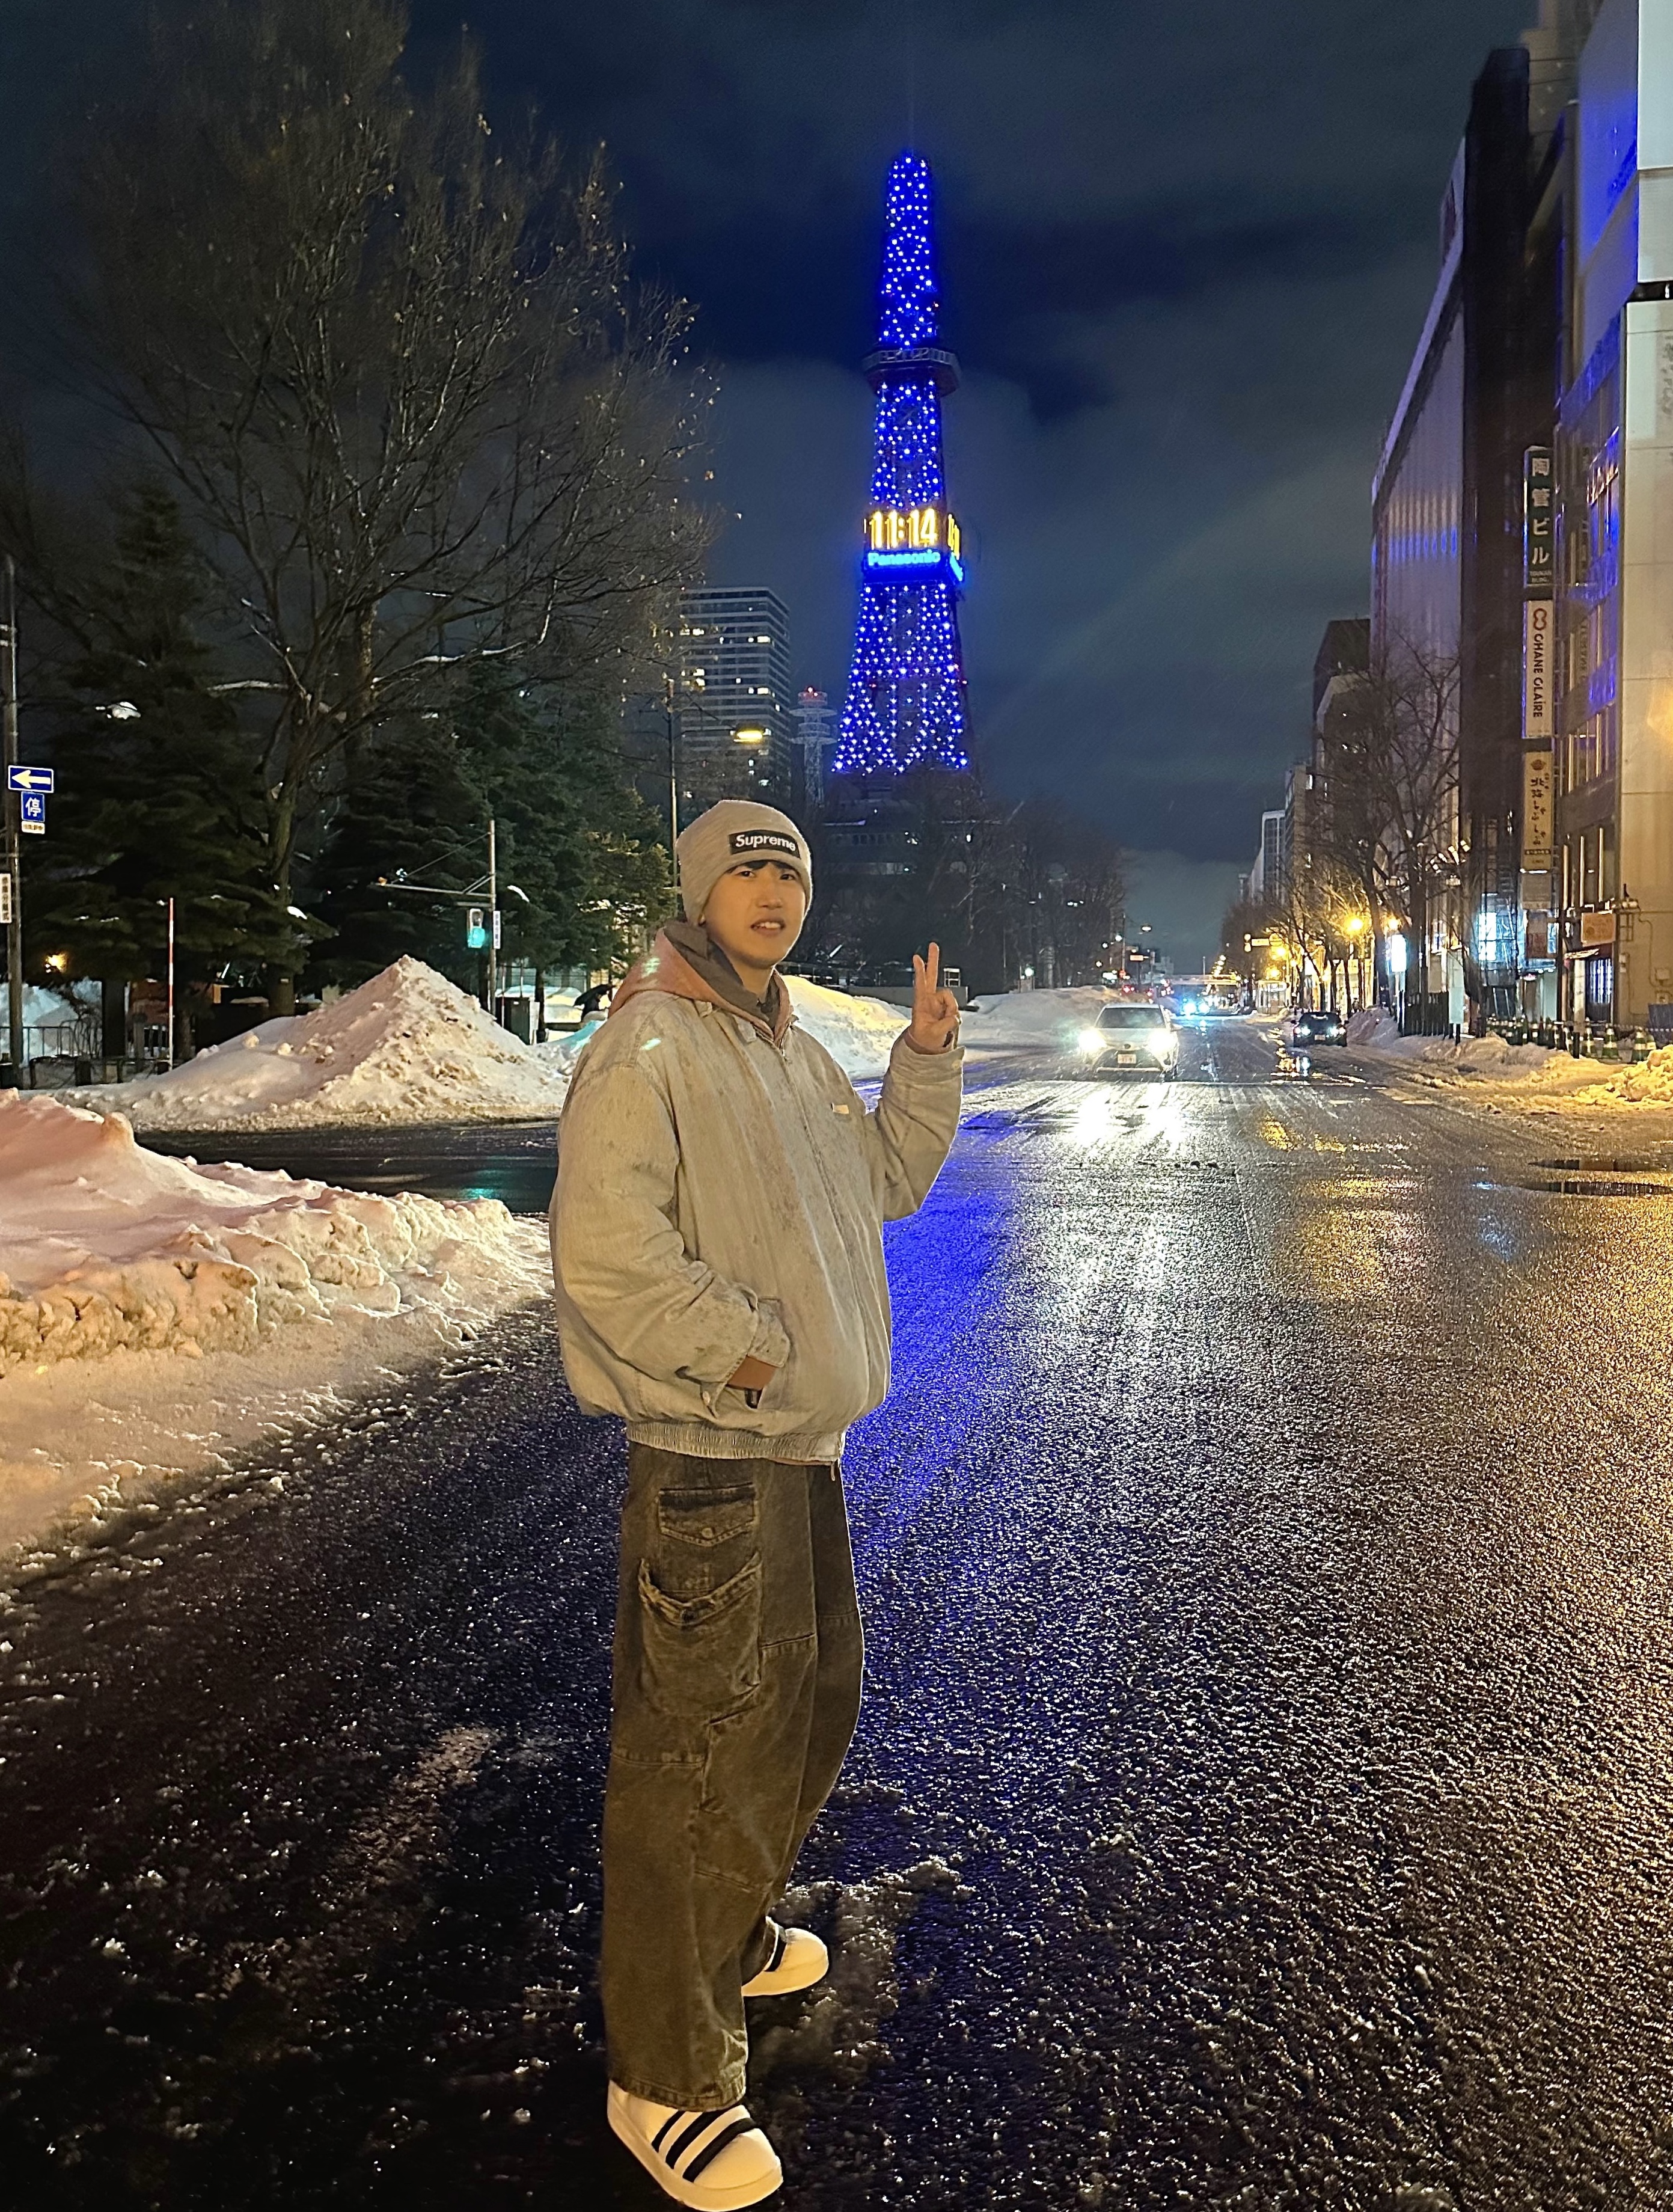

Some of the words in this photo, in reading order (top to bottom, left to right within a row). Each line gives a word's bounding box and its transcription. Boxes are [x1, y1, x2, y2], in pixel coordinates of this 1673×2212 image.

[869, 508, 938, 550] 11:14
[25, 797, 41, 817] 停
[735, 834, 796, 851] Supreme
